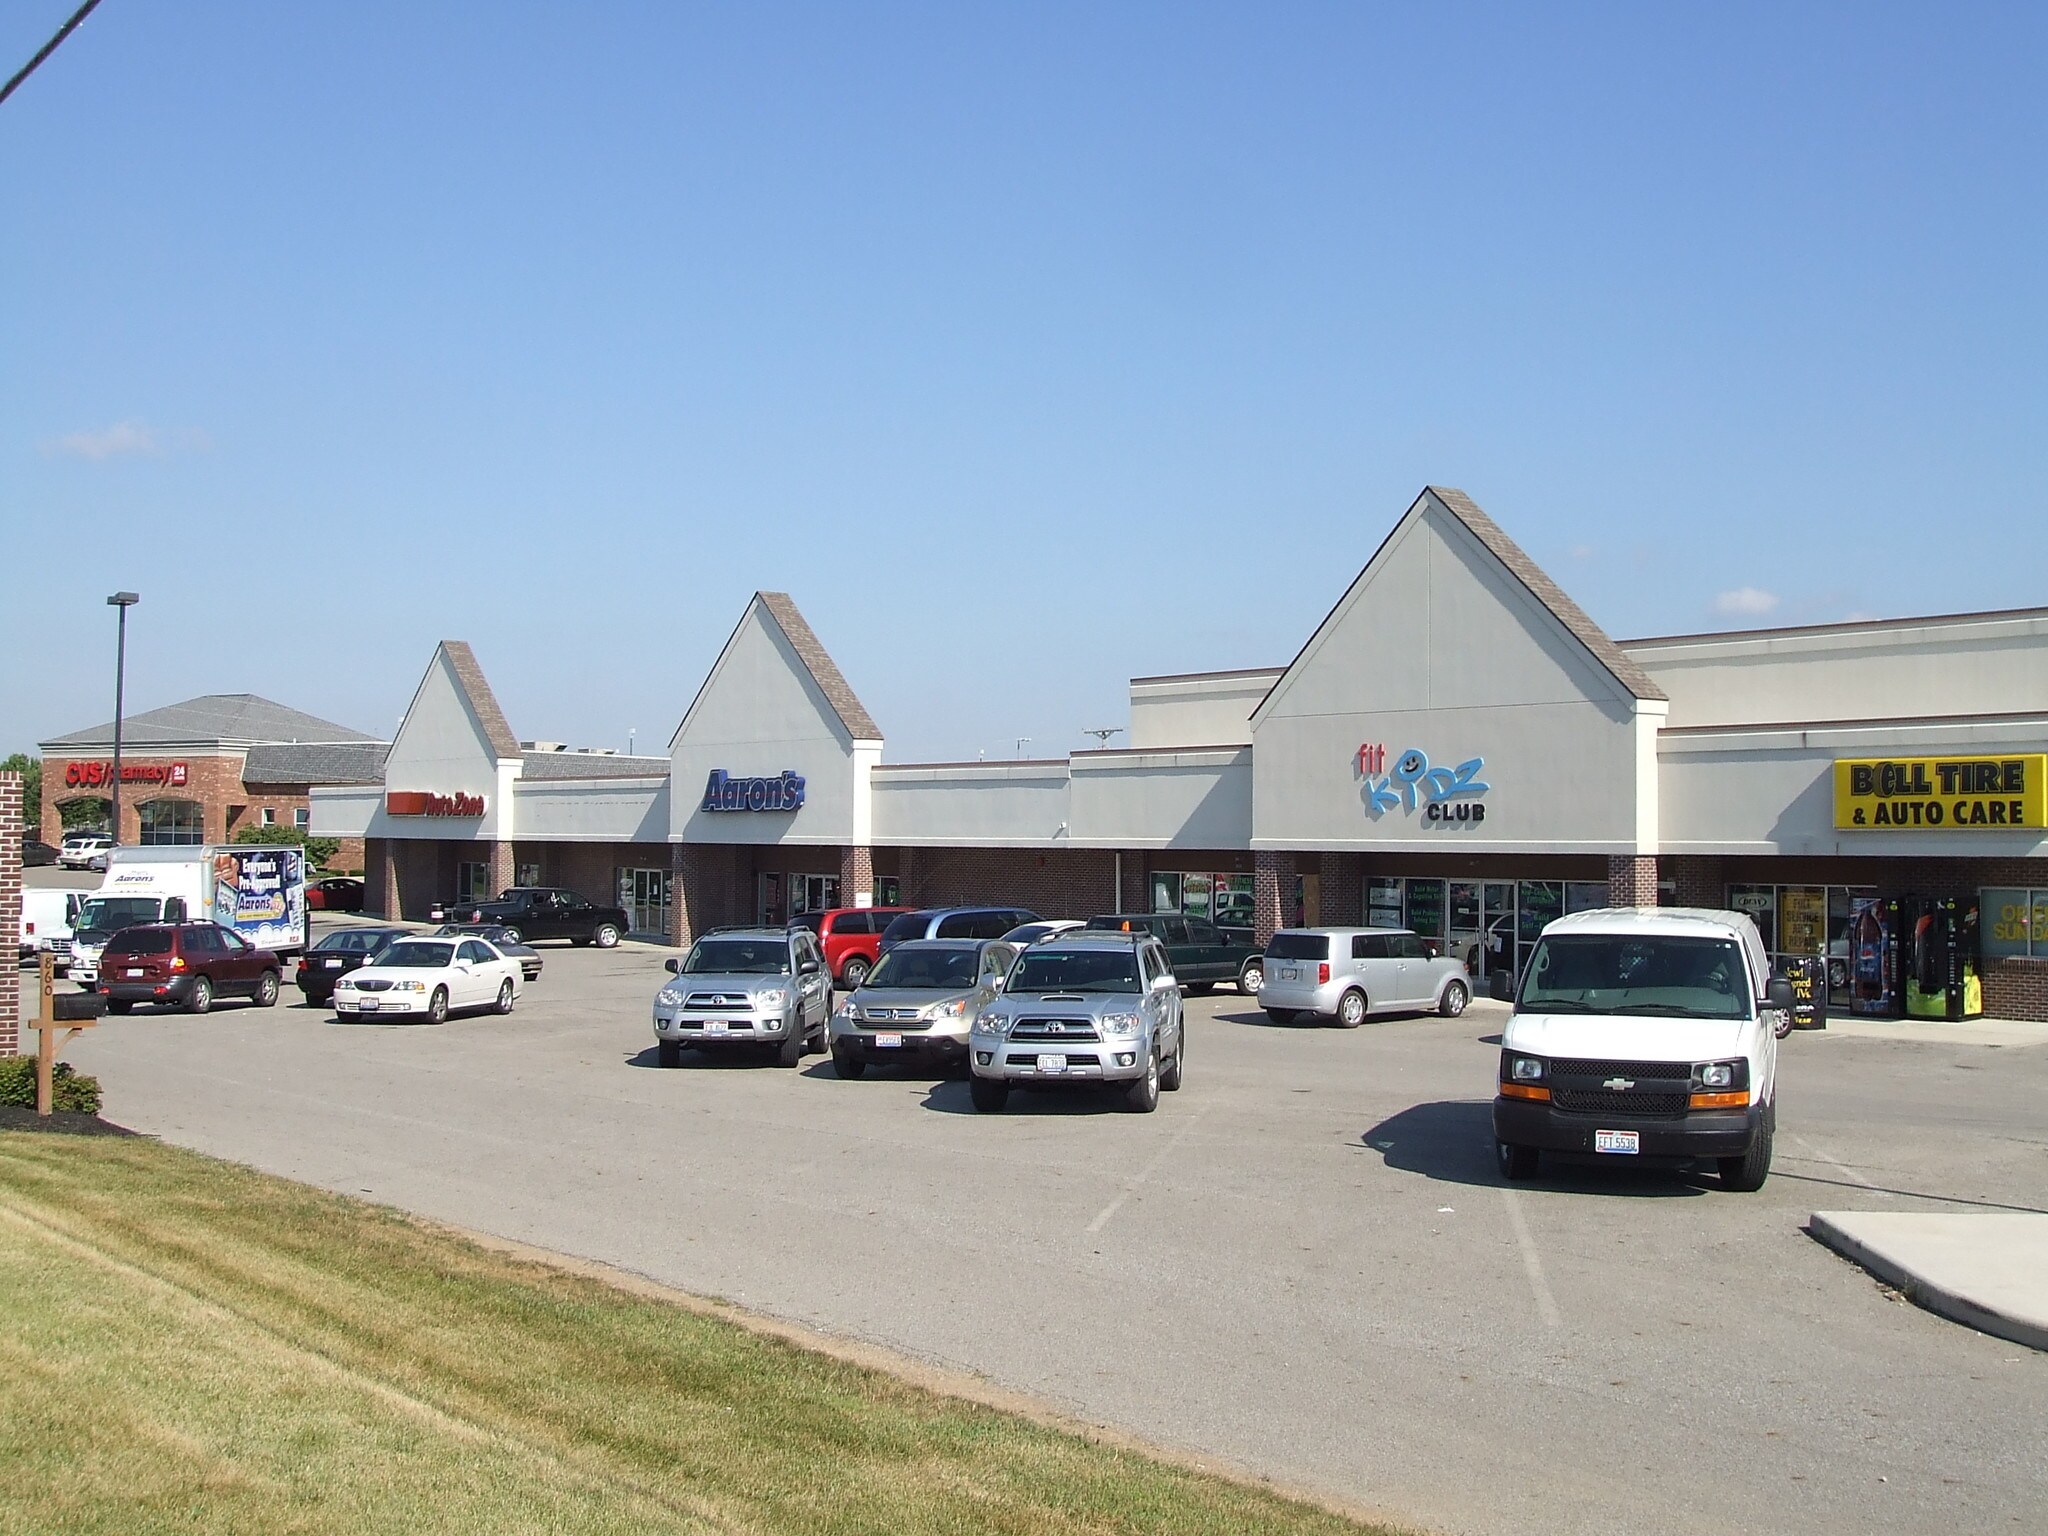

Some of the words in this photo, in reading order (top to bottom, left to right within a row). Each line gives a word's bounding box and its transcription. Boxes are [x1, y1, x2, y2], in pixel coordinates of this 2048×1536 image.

[1359, 744, 1385, 773] fit
[701, 768, 805, 812] Aaron's
[1936, 761, 2024, 795] TIRE
[1427, 803, 1485, 821] CLUB
[1852, 807, 1866, 824] &
[1874, 802, 1944, 825] AUTO
[1953, 800, 2023, 824] CARE
[1598, 1136, 1613, 1148] EFT
